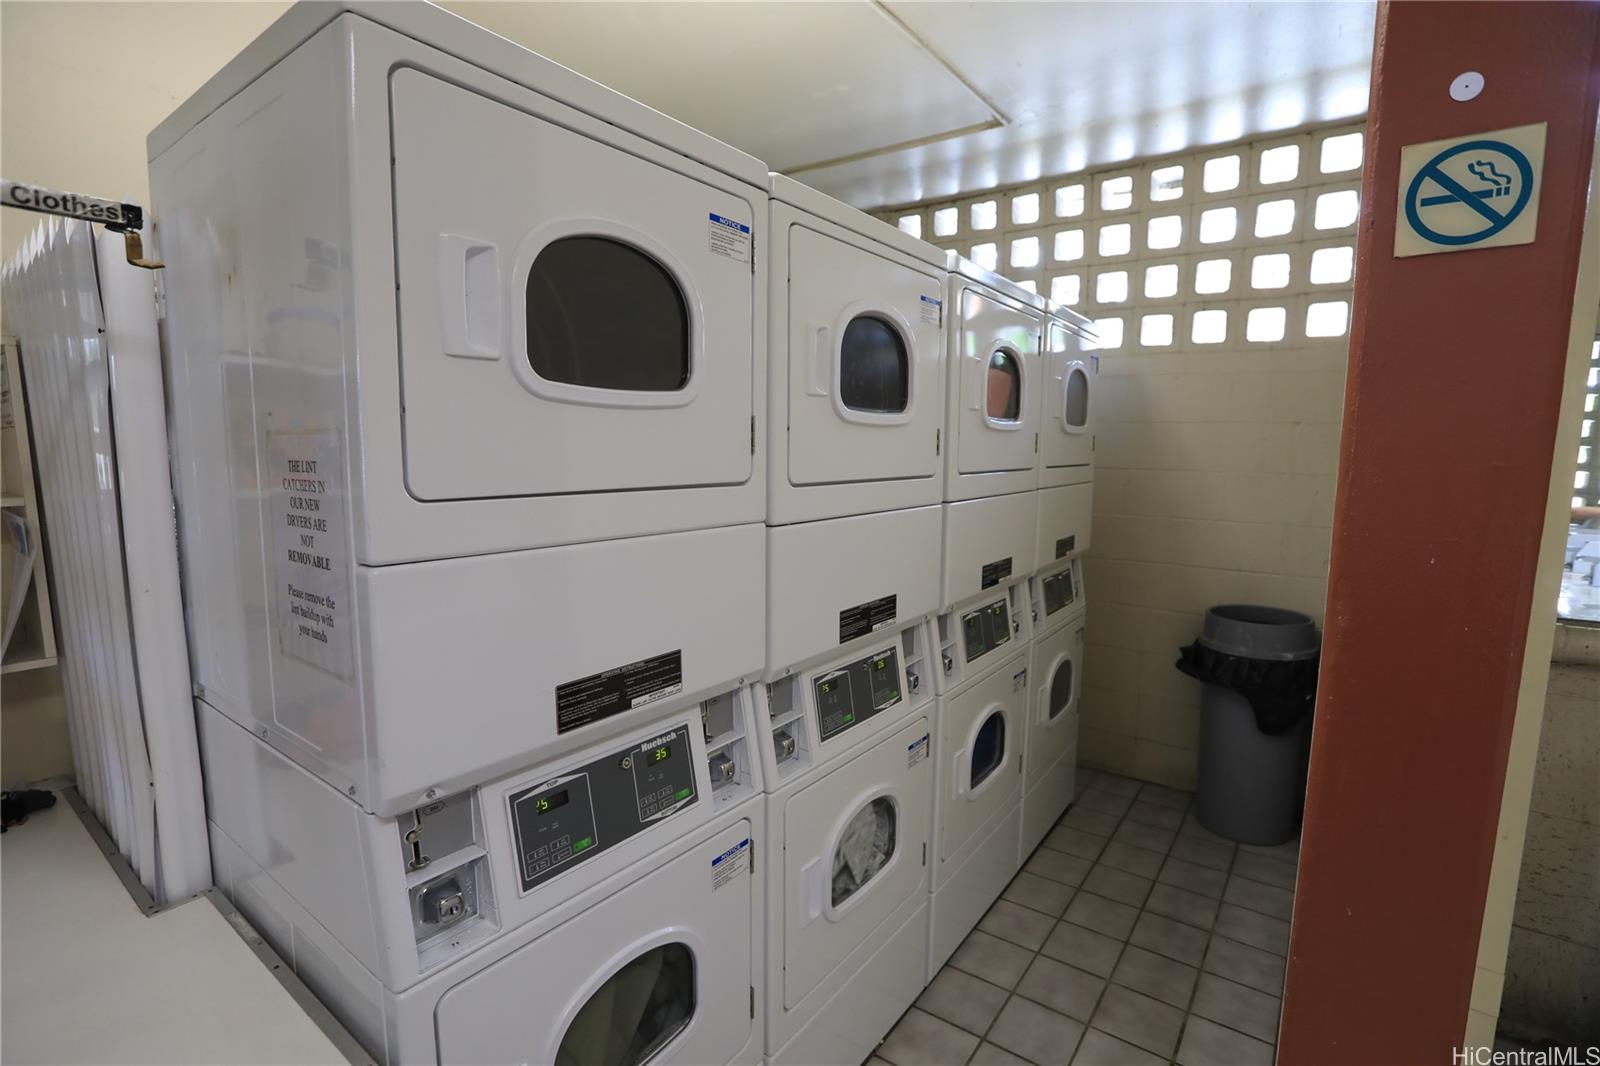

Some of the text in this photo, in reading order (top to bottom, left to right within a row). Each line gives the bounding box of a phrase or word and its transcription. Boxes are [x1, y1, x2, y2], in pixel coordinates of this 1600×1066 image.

[719, 217, 741, 230] NOTICE
[288, 459, 317, 474] THE LINT
[283, 478, 325, 494] CATCHERS IN
[290, 496, 320, 512] OUR NEW
[287, 513, 327, 533] DRYERS ARE
[300, 534, 314, 548] NOT
[288, 549, 331, 571] REMOVABLE
[288, 583, 335, 610] Please remove the
[321, 613, 334, 628] with
[299, 625, 310, 636] your
[641, 731, 677, 752] Huebsch
[655, 747, 667, 761] 35
